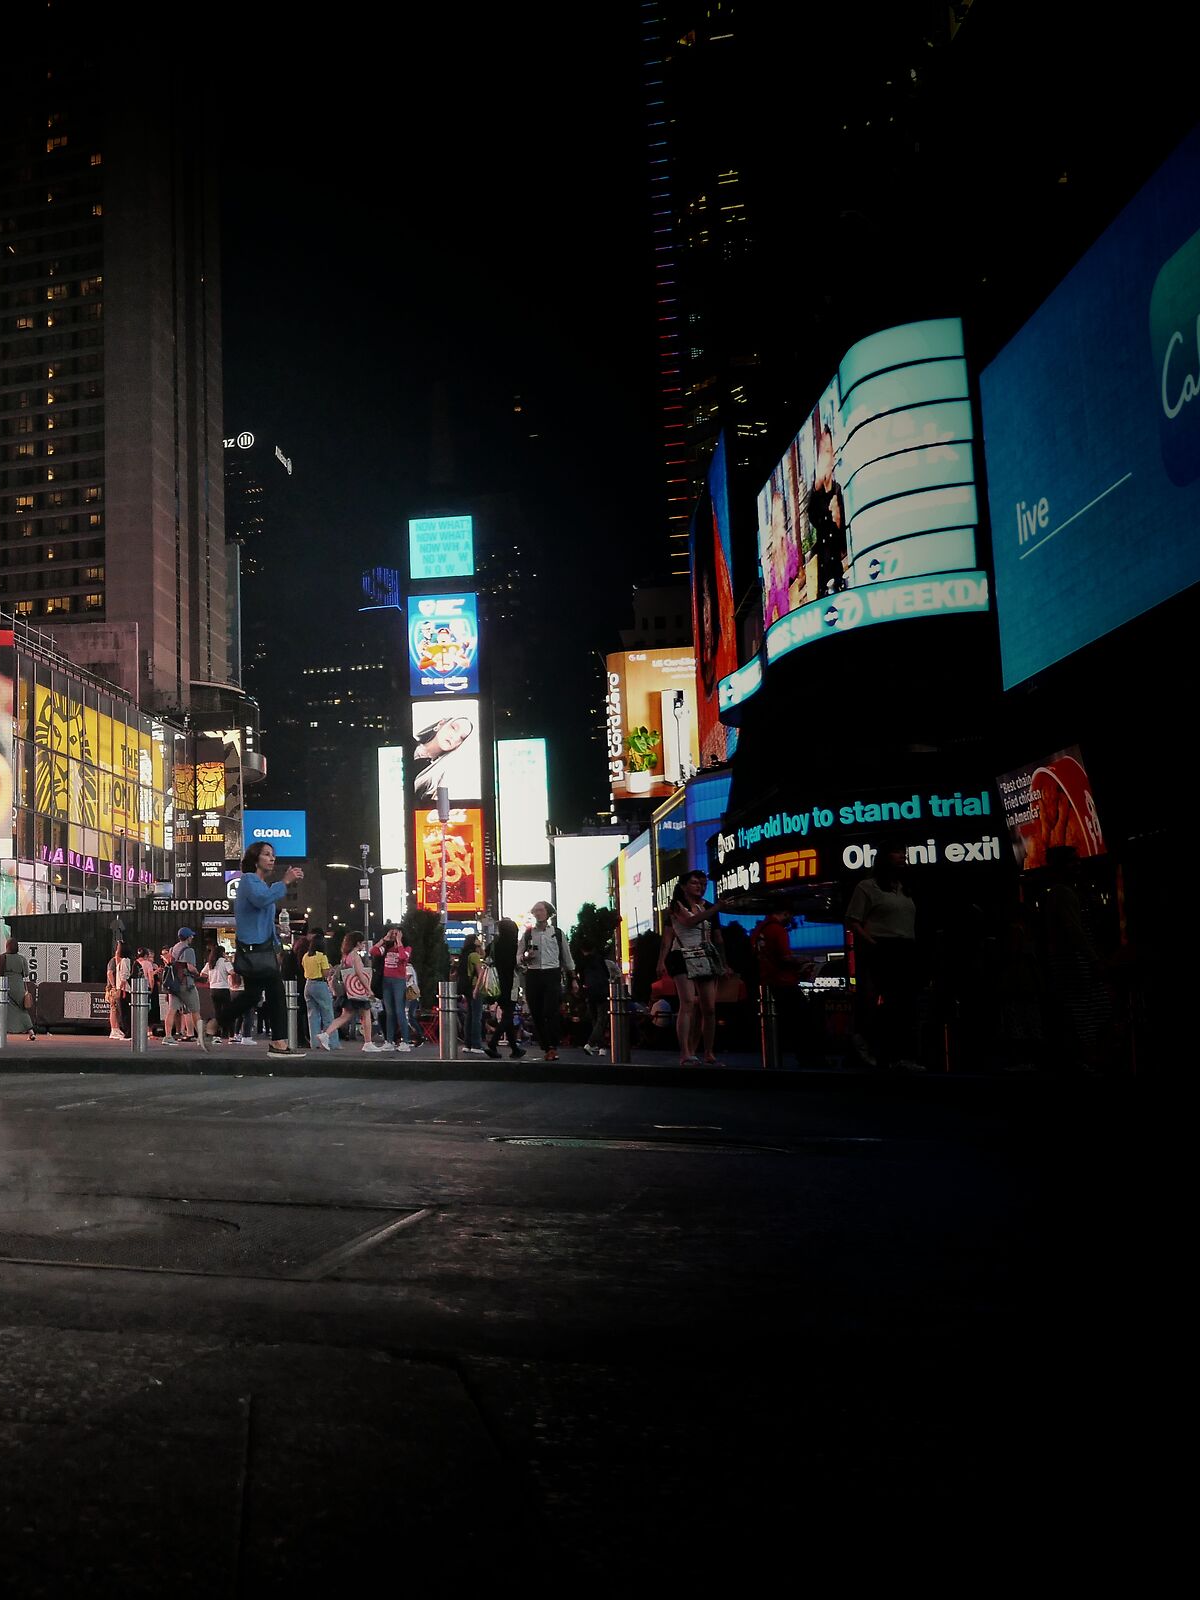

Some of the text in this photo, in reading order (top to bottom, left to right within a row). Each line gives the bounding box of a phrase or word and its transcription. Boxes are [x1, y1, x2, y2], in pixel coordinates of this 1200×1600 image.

[1016, 497, 1049, 545] live
[252, 828, 291, 839] GLOBAL
[738, 814, 782, 850] 11-year-old
[783, 812, 810, 836] boy
[813, 806, 834, 828] to
[839, 794, 921, 825] stand
[928, 791, 991, 817] trial
[766, 848, 817, 883] ESPN
[842, 838, 937, 870] Ohni
[170, 900, 230, 911] HOTDOGS
